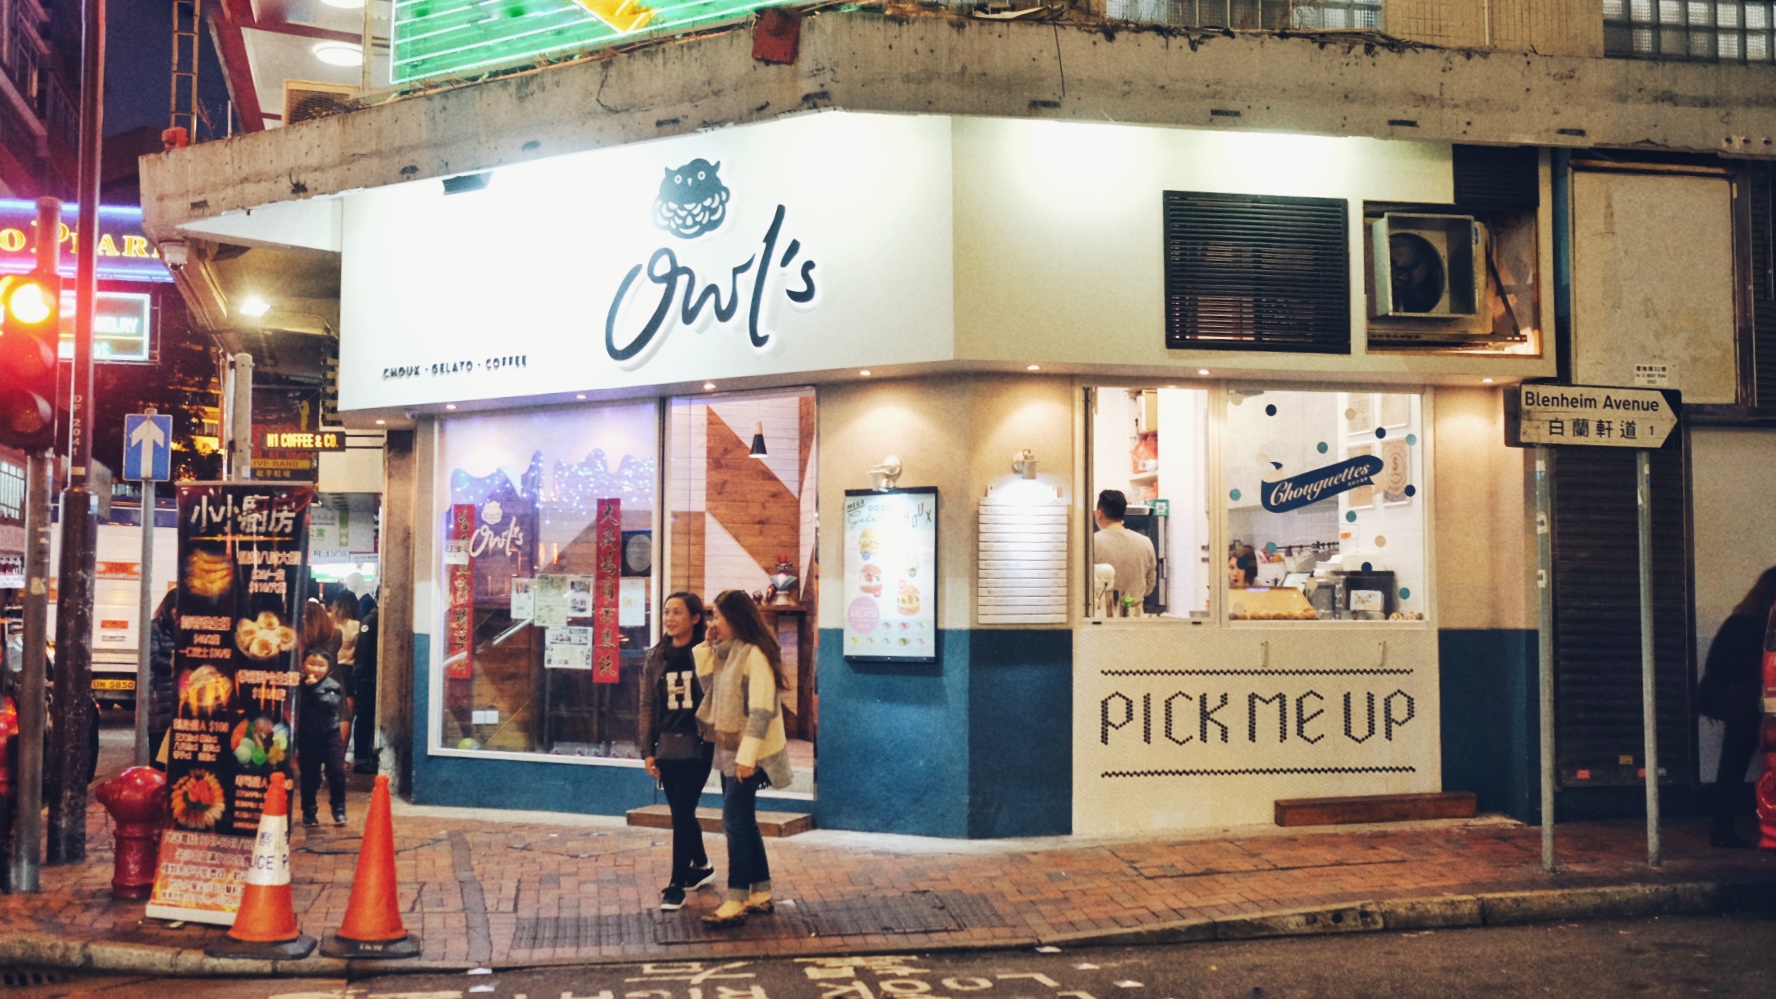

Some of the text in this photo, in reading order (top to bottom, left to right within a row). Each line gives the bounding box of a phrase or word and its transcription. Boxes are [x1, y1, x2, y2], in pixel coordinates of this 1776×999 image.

[604, 203, 816, 361] Owl's
[383, 354, 527, 379] CHOUX GELATO COFFEE
[1524, 390, 1660, 412] Blenheim Avenue
[281, 433, 314, 448] COFFEE
[315, 434, 324, 448] &
[324, 433, 339, 448] CO.
[1549, 417, 1655, 440] 白蘭軒道 1
[847, 499, 866, 511] MEGA
[469, 516, 524, 558] Owl's
[93, 681, 134, 690] UM 5850
[665, 670, 694, 711] H
[1100, 688, 1416, 746] PICK ME UP
